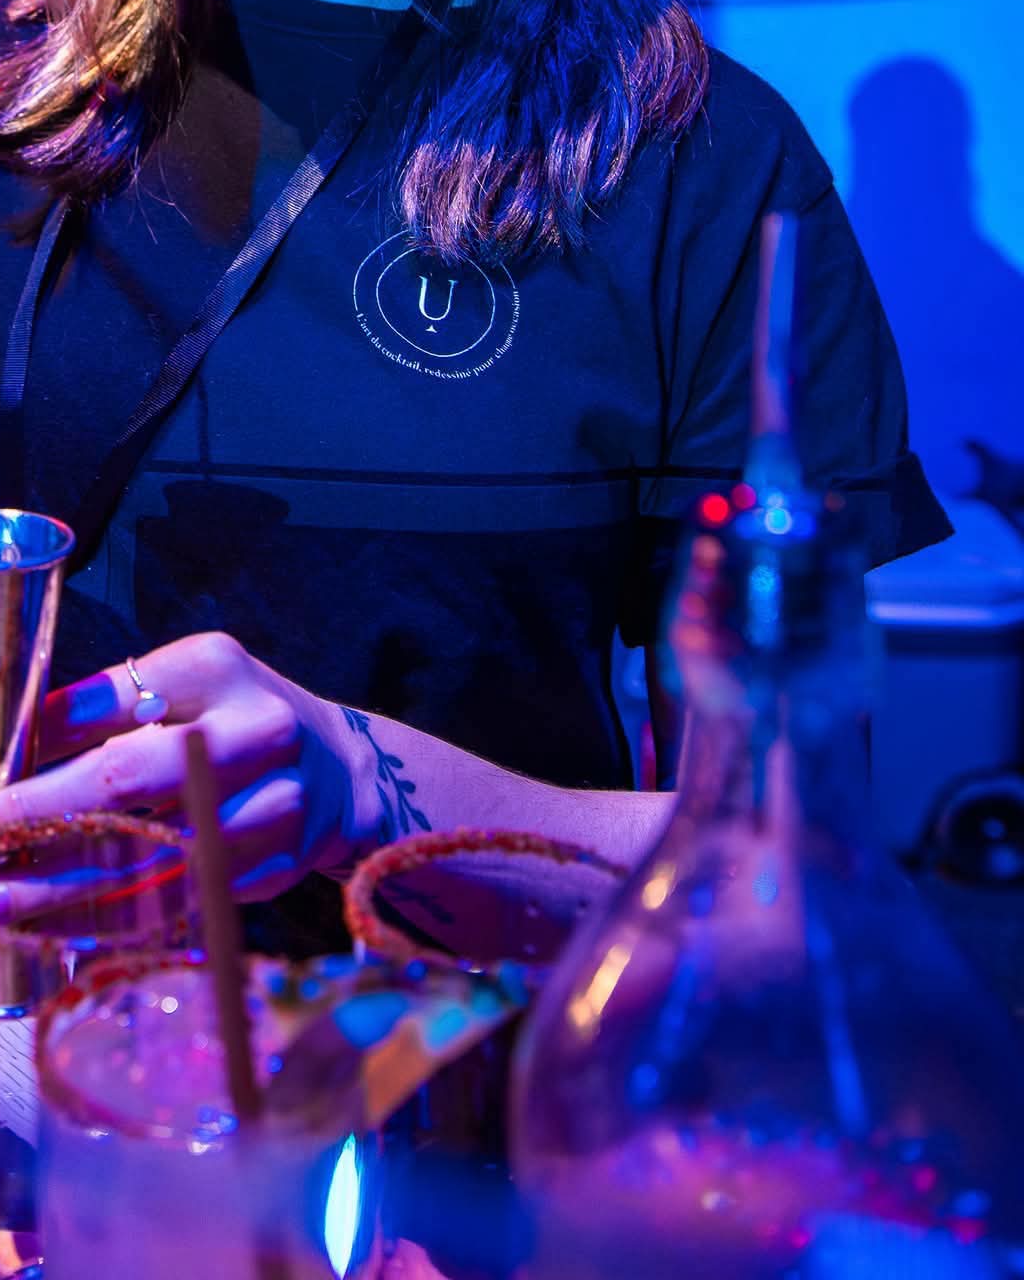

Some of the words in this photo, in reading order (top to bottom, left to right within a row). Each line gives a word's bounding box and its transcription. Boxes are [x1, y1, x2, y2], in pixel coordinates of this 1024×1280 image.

[418, 274, 459, 321] U
[381, 346, 422, 373] cocktail,
[424, 366, 473, 380] redessiné
[472, 356, 495, 377] pour
